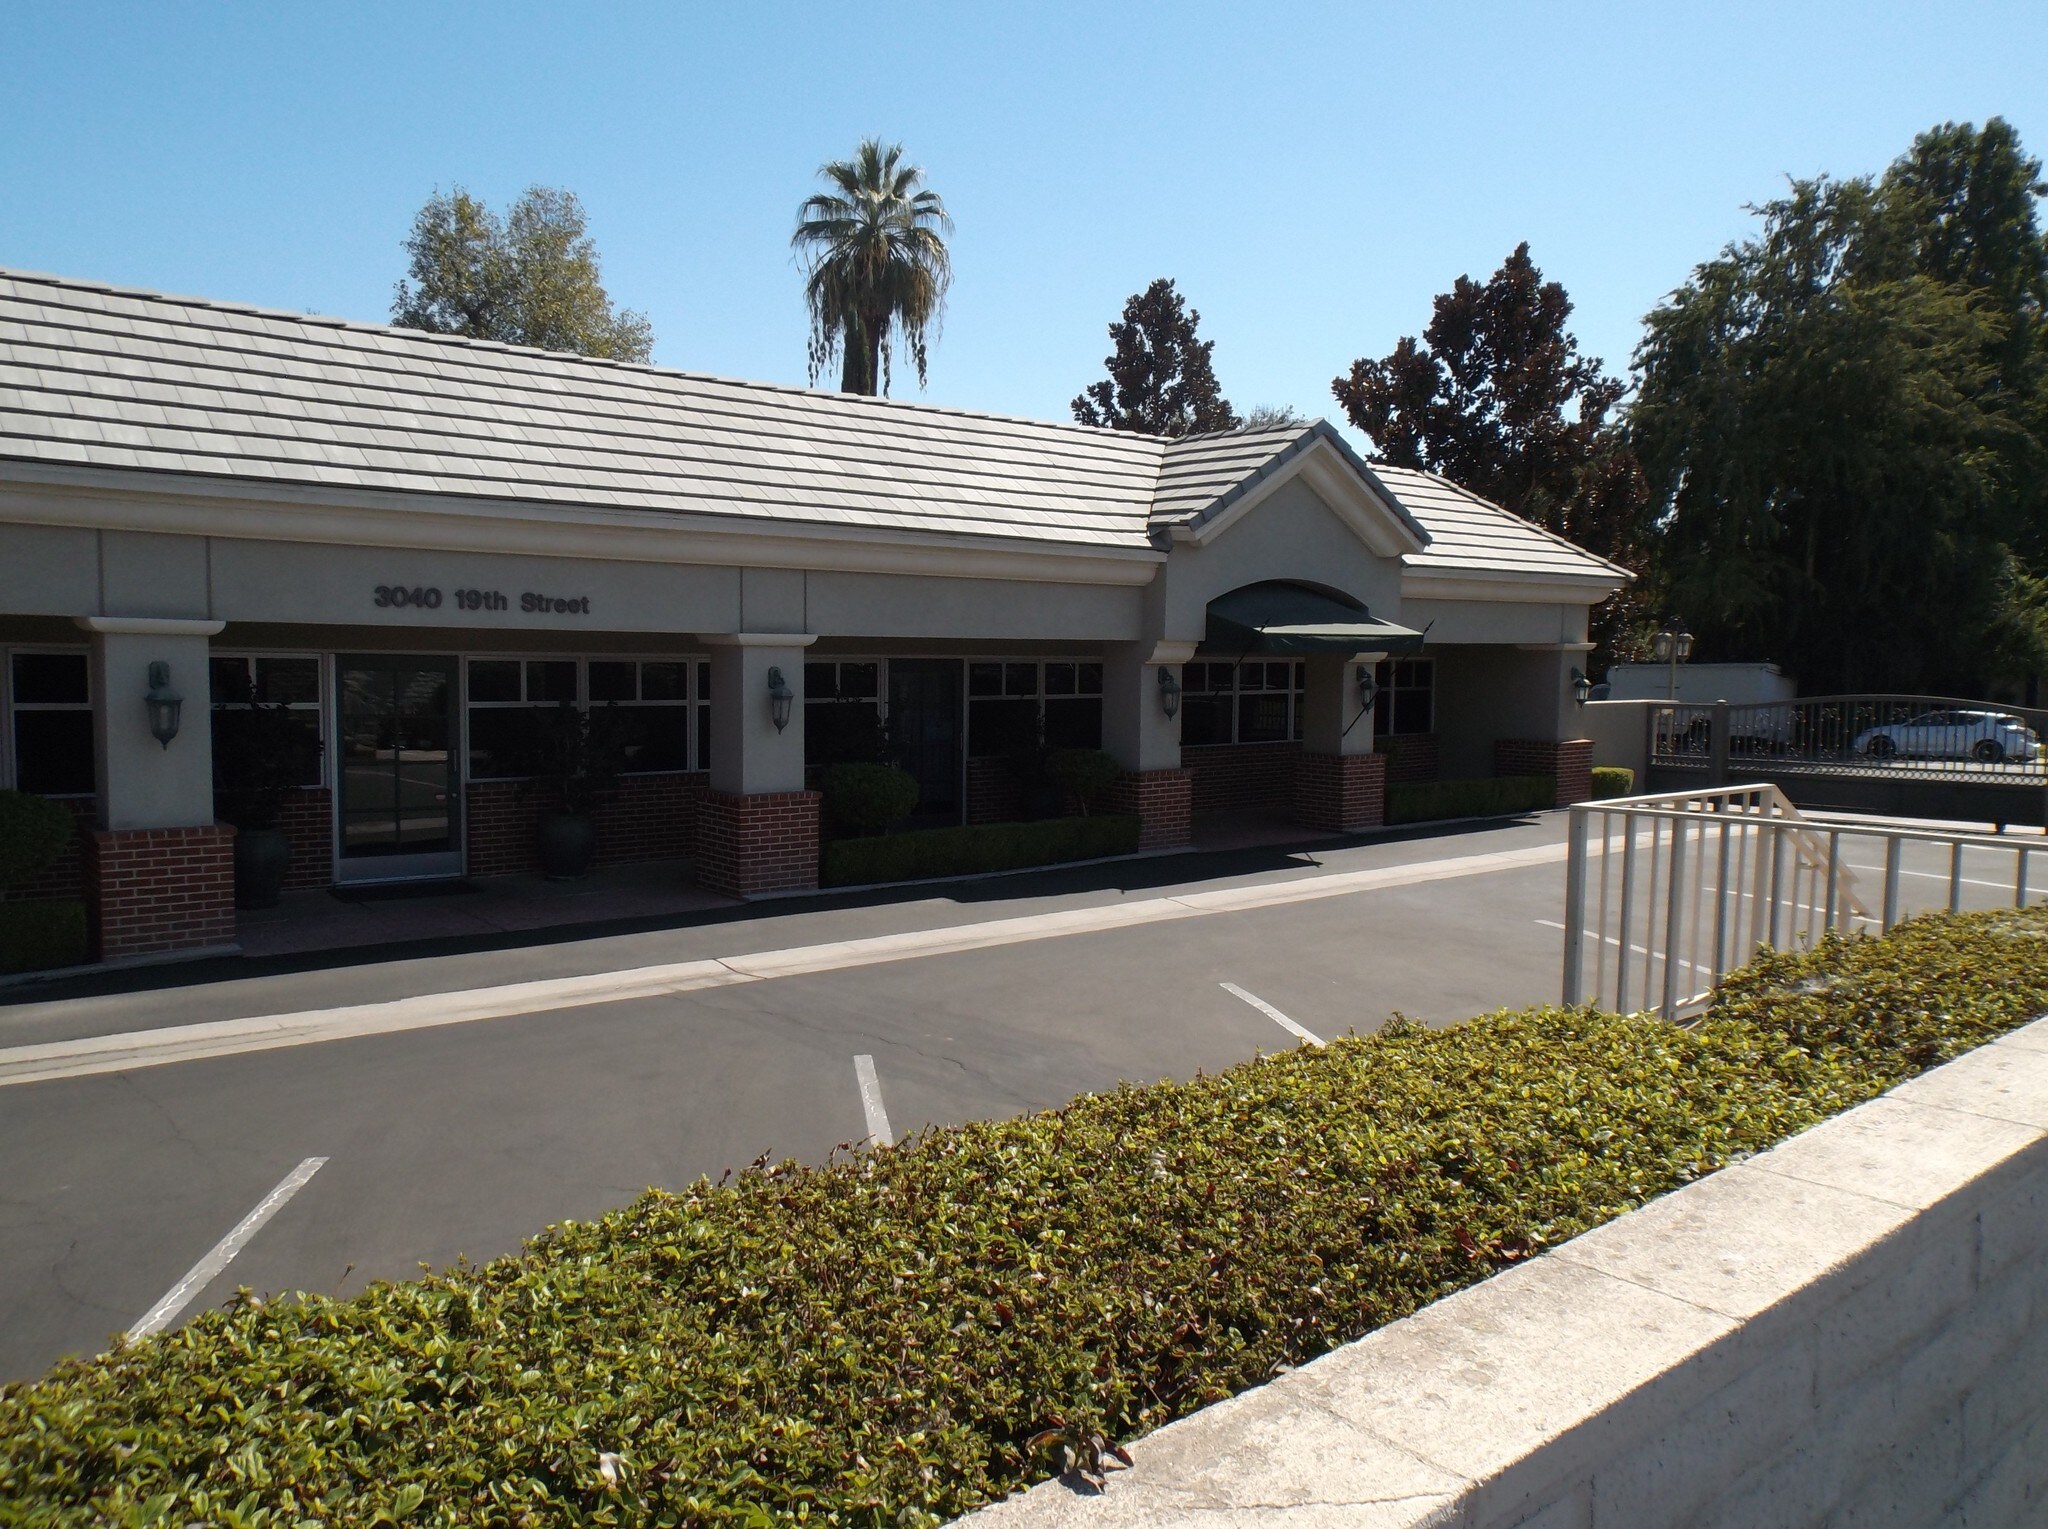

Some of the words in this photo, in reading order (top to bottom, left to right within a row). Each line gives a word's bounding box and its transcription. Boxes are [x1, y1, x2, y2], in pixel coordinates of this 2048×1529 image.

[374, 585, 442, 609] 3040
[454, 589, 508, 611] 19th
[520, 592, 590, 614] Street
